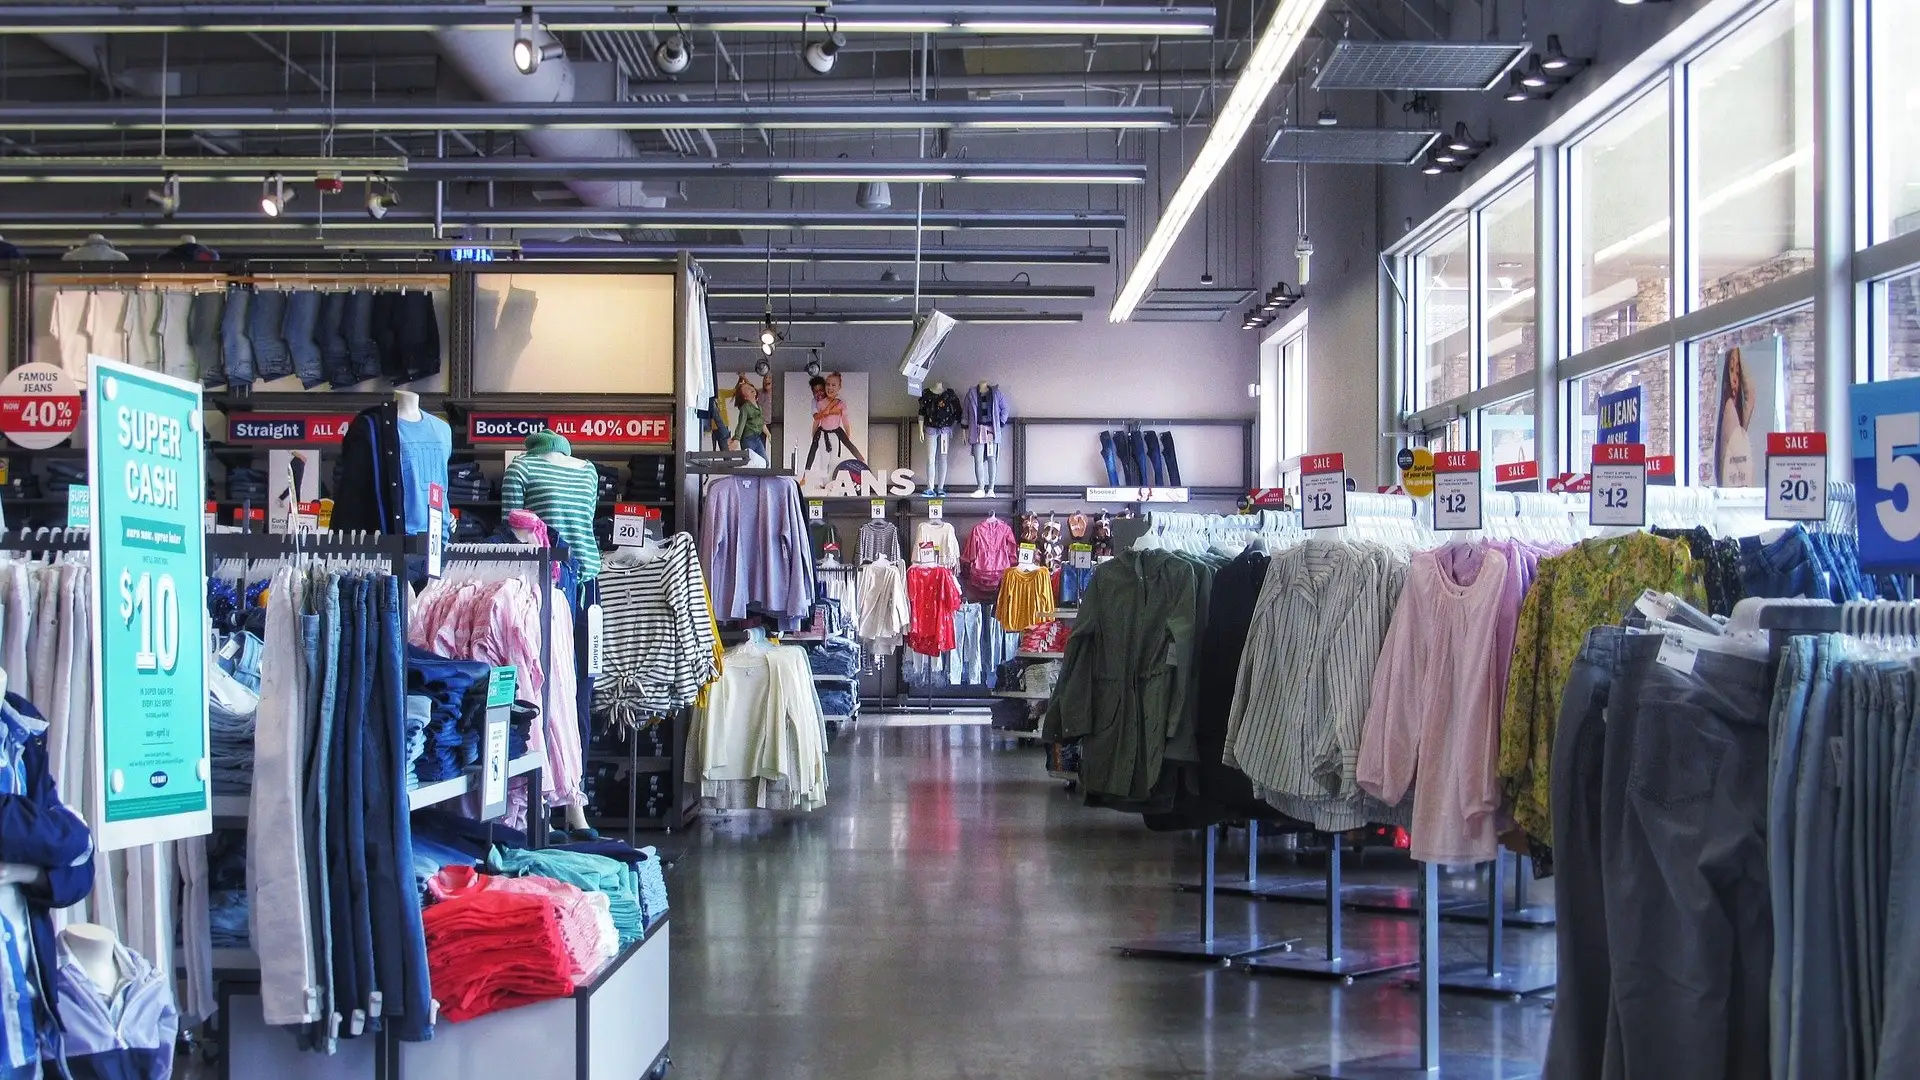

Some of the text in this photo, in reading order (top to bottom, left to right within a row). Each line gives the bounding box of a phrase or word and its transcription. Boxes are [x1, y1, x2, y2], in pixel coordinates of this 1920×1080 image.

[18, 372, 58, 382] FAMOUS
[23, 383, 53, 393] JEANS
[3, 402, 20, 410] NOW
[1599, 397, 1638, 430] ALL JEANS
[57, 418, 72, 427] OFF
[1858, 415, 1868, 426] UP
[117, 405, 182, 461] SUPER
[236, 423, 300, 439] Straight
[312, 424, 333, 436] ALL
[476, 420, 666, 436] Boot-Cut ALL 40% OFF
[1860, 429, 1868, 440] TO
[1785, 436, 1808, 449] SALE
[1608, 447, 1629, 460] SALE
[1313, 457, 1330, 470] SALE
[1448, 455, 1466, 467] SALE
[1646, 460, 1660, 470] ALE
[1508, 465, 1525, 476] SALE
[125, 460, 178, 511] CASH
[1307, 492, 1333, 512] $12
[1440, 494, 1466, 513] $12
[1598, 487, 1628, 508] $12
[119, 566, 179, 676] $10
